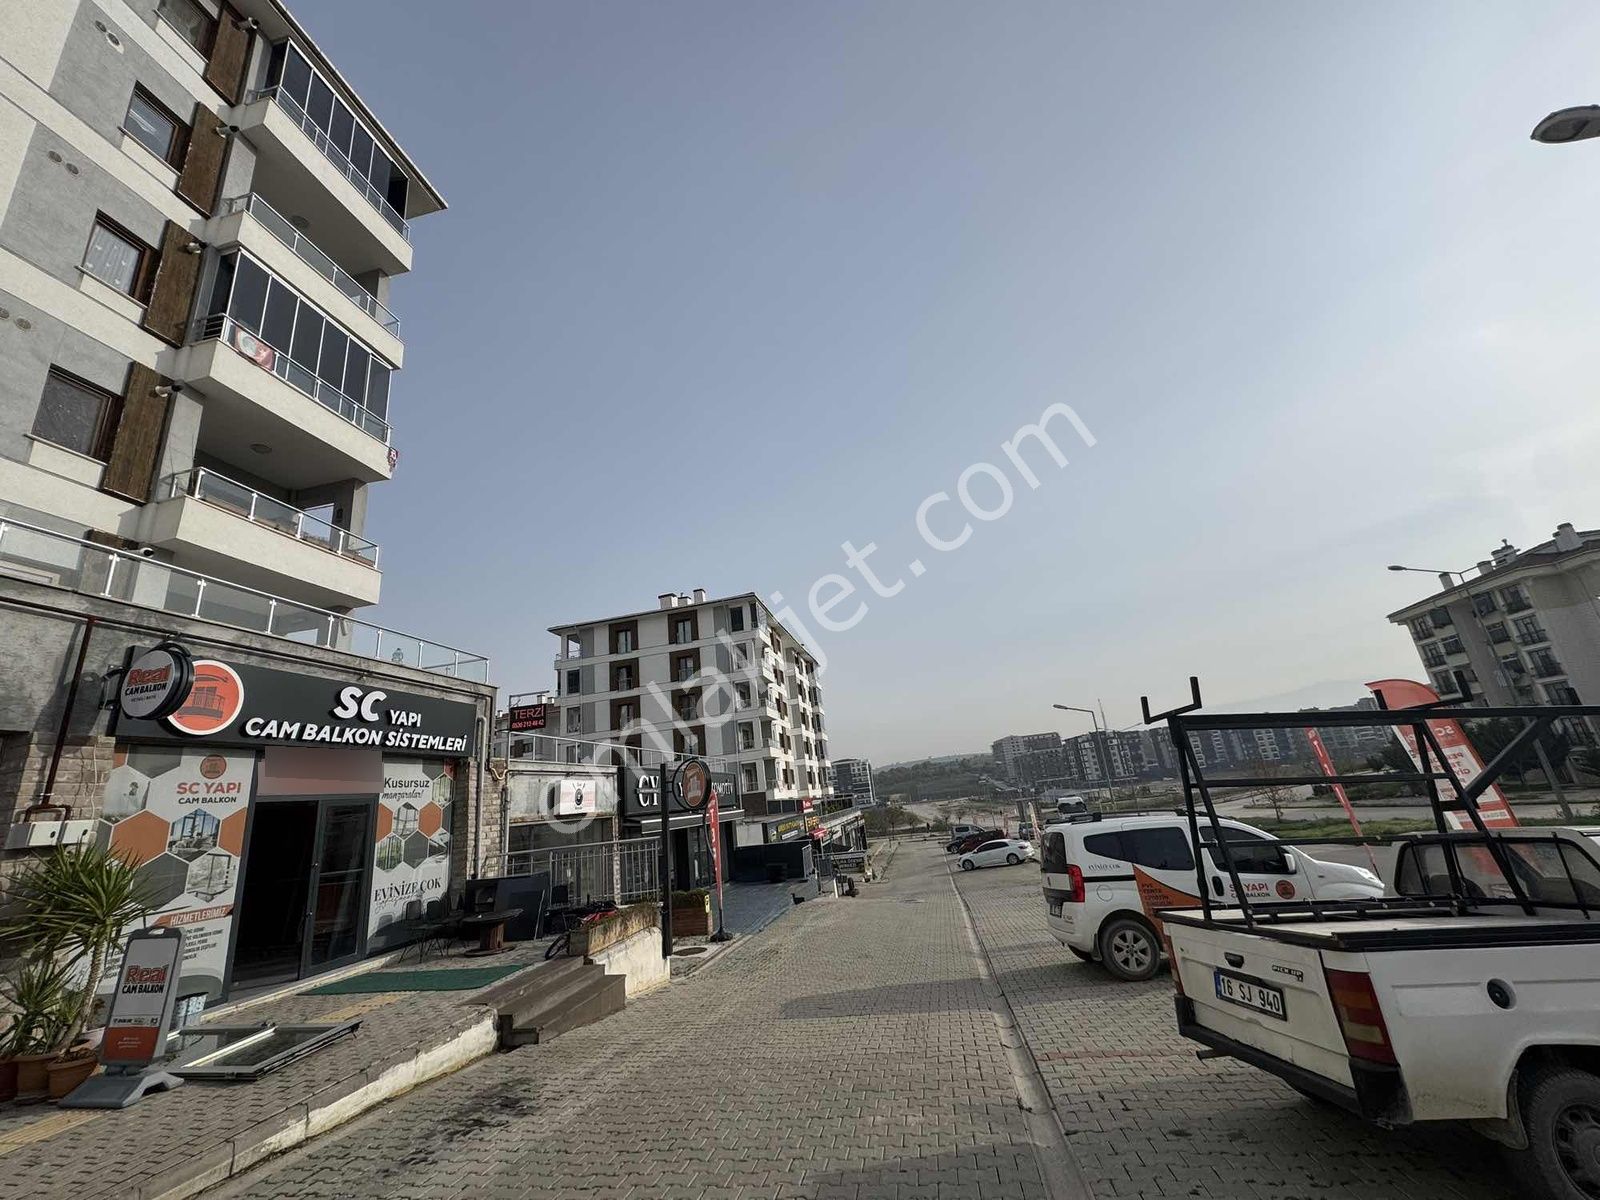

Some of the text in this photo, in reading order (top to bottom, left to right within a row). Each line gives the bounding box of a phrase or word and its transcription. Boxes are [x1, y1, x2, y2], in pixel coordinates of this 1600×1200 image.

[127, 663, 172, 688] Real
[124, 682, 168, 696] CAM BALKON
[333, 686, 421, 727] SC YAPI
[245, 717, 467, 752] CAM BALKON SİSTEMLERİ
[177, 782, 241, 795] SC YAPI
[384, 777, 430, 788] Kusursuz
[201, 796, 237, 804] BALKON
[1243, 883, 1269, 891] YAPI
[124, 964, 169, 984] Real
[122, 983, 164, 994] CAM BALKON
[1221, 978, 1281, 1012] 16 SJ 940
